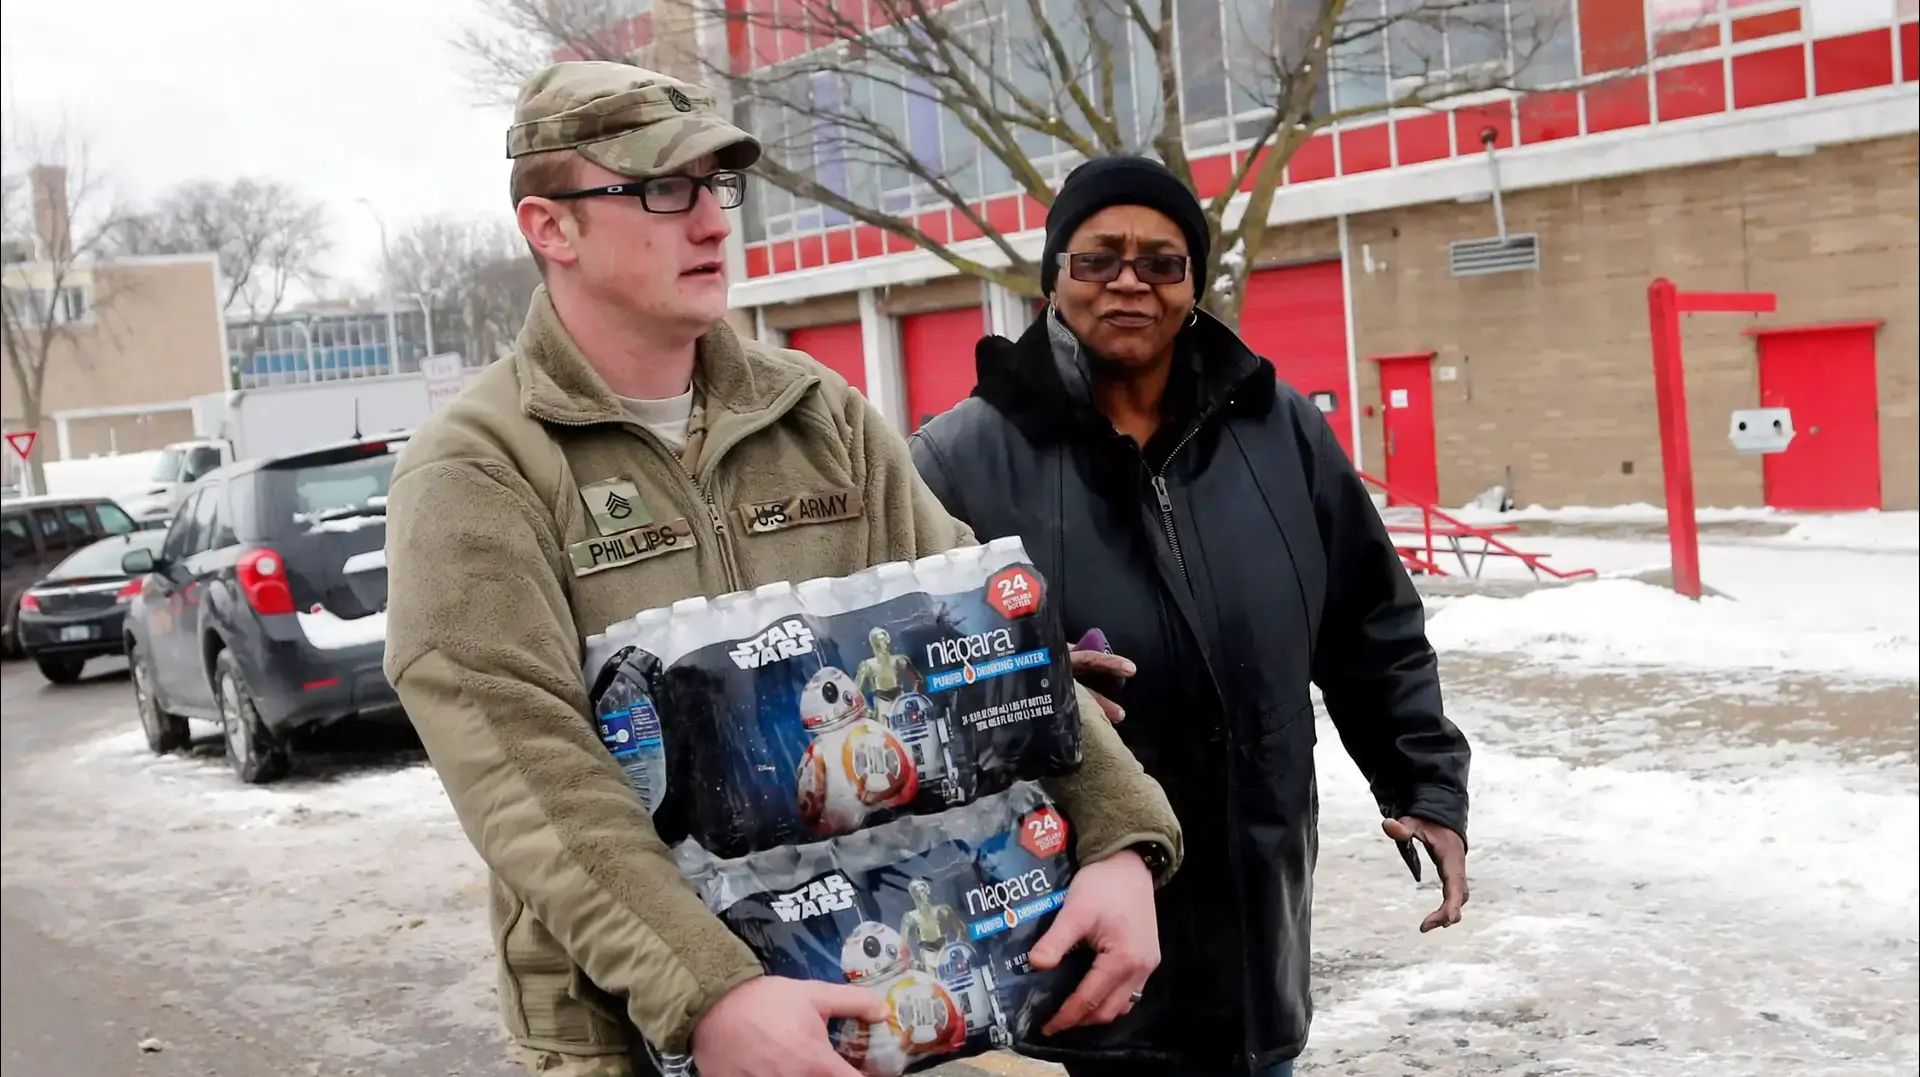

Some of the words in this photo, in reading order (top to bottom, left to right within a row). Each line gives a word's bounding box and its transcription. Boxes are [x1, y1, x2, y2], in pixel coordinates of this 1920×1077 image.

[754, 504, 792, 527] U.S.
[799, 494, 848, 519] ARMY
[589, 526, 677, 565] PHILLIPS
[997, 574, 1028, 598] 24
[729, 620, 811, 656] STAR
[731, 634, 814, 670] WARS
[926, 628, 1014, 674] niagara
[976, 659, 1013, 677] DRINKING
[1015, 652, 1045, 668] WATER
[1028, 694, 1052, 707] BOTTLES
[1028, 814, 1057, 839] 24
[770, 875, 853, 908] STAR
[773, 889, 855, 922] WARS
[966, 868, 1051, 920] niagara
